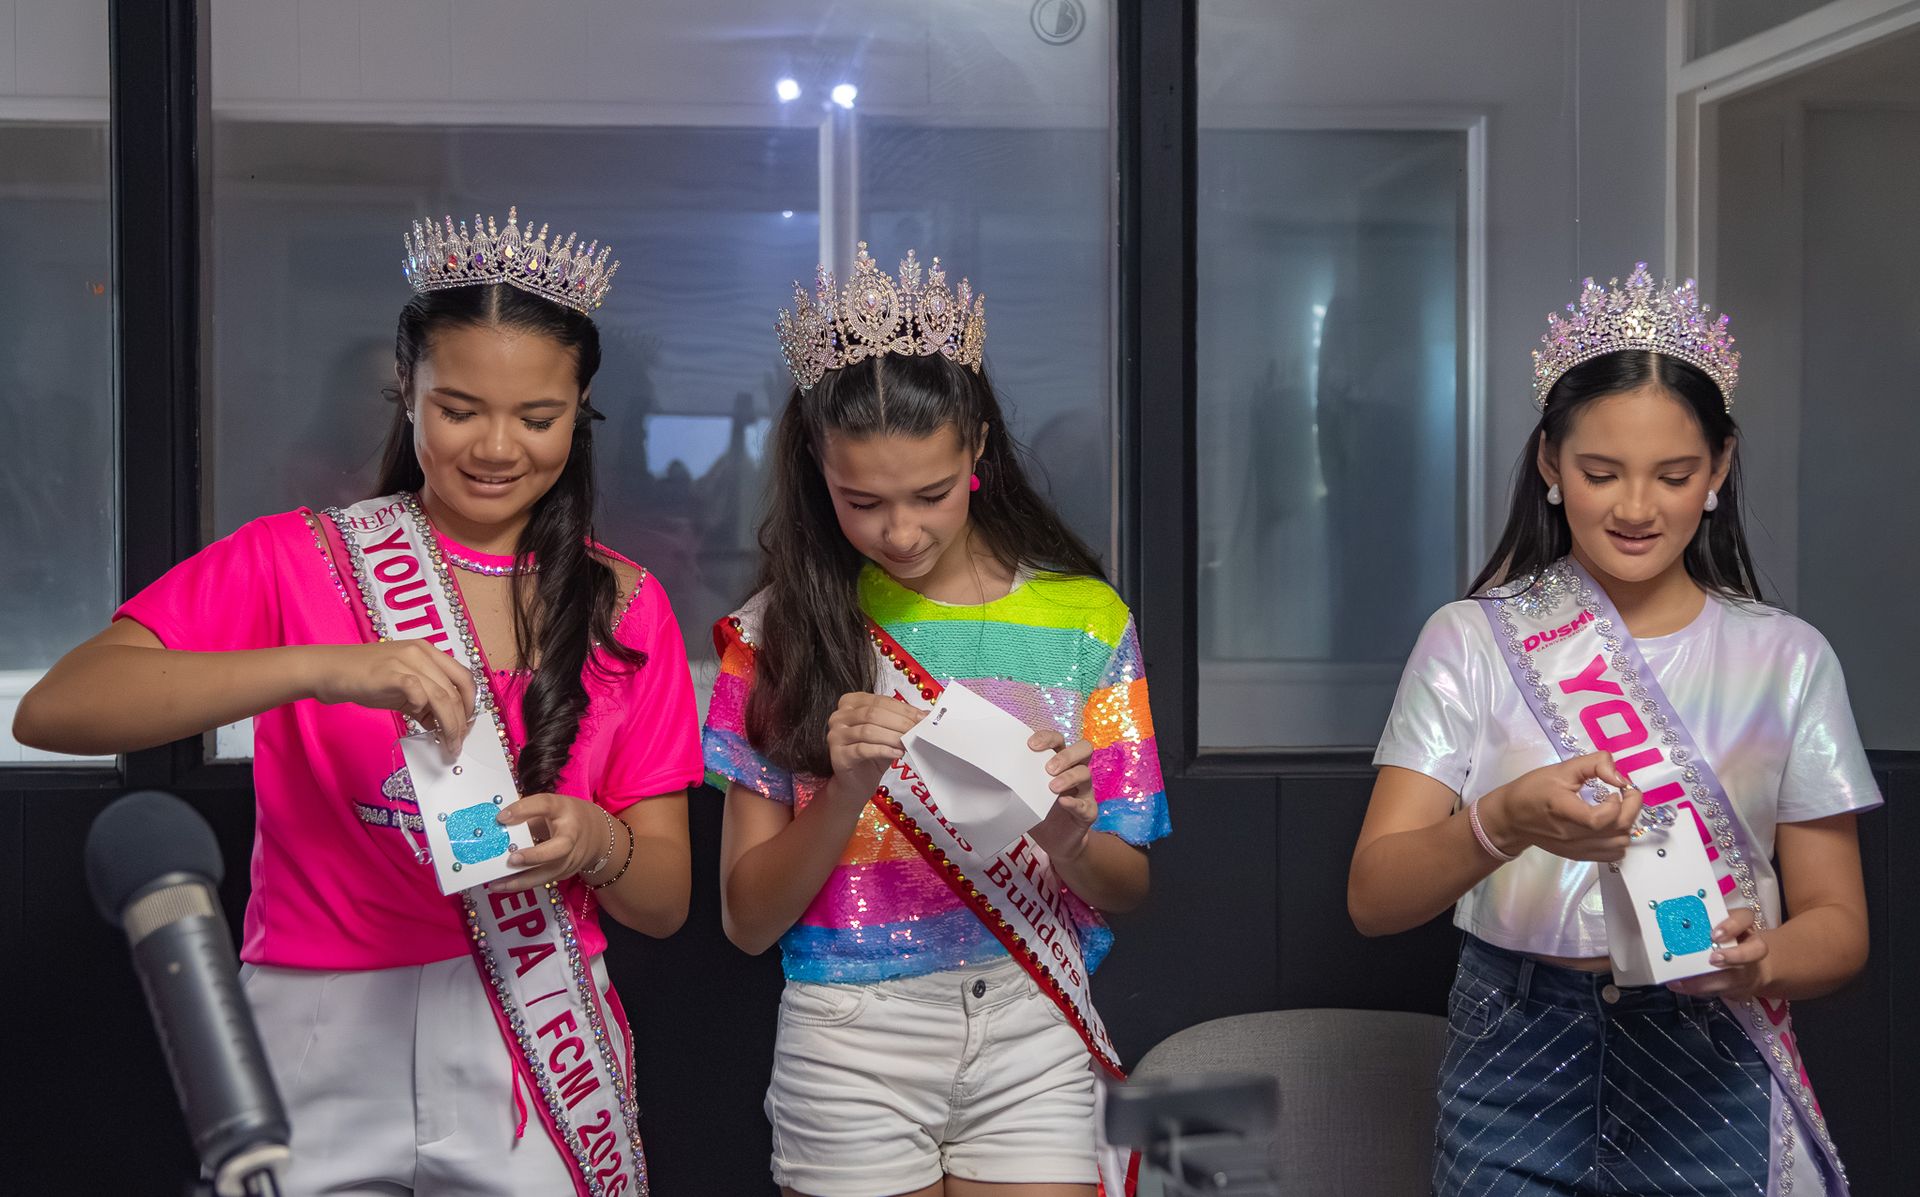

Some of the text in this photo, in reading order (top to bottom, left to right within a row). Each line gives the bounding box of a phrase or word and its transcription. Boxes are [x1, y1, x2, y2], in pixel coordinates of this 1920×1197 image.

[1523, 609, 1595, 652] DUSHI
[983, 857, 1081, 987] Builders
[536, 1009, 601, 1110] FCM
[576, 1108, 628, 1197] 2026
